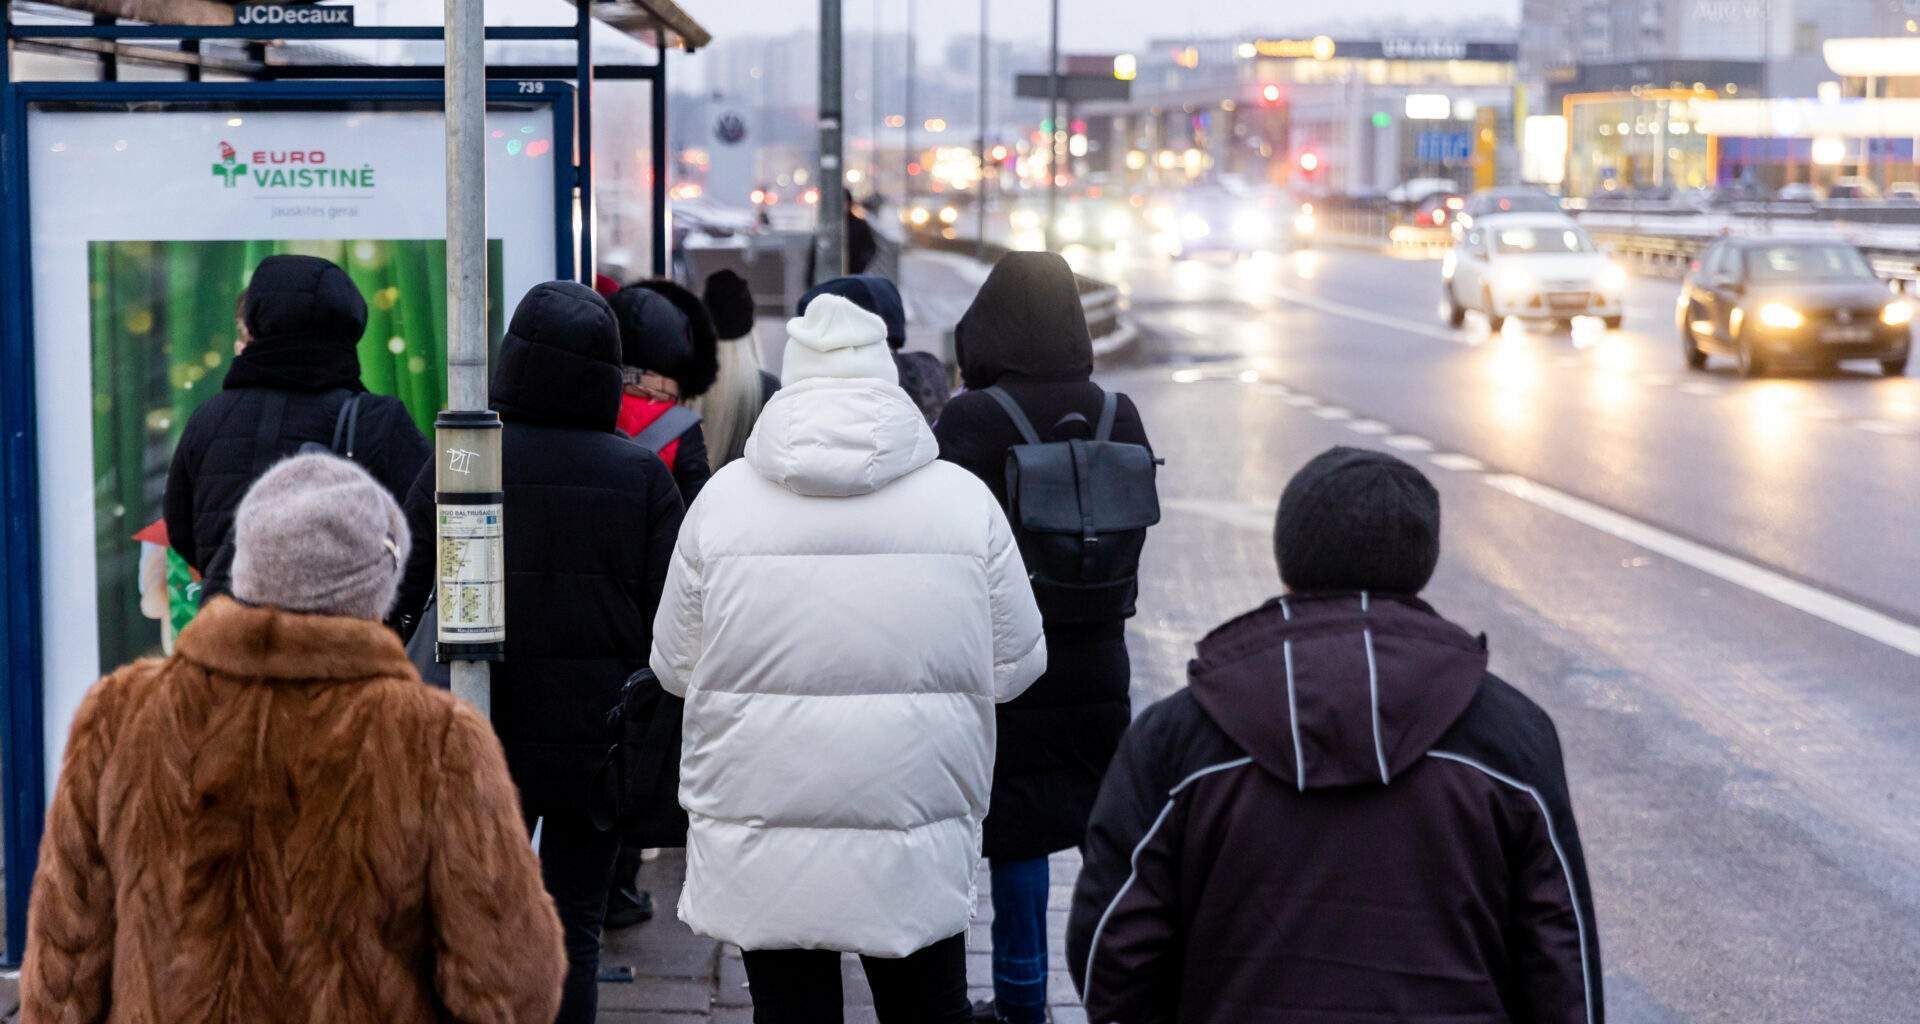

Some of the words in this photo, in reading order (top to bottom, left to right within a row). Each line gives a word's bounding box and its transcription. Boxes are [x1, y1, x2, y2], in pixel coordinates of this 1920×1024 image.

[238, 5, 349, 24] JCDecaux
[517, 81, 545, 94] 739
[252, 151, 326, 164] EURO
[252, 164, 375, 188] VAISTINĖ
